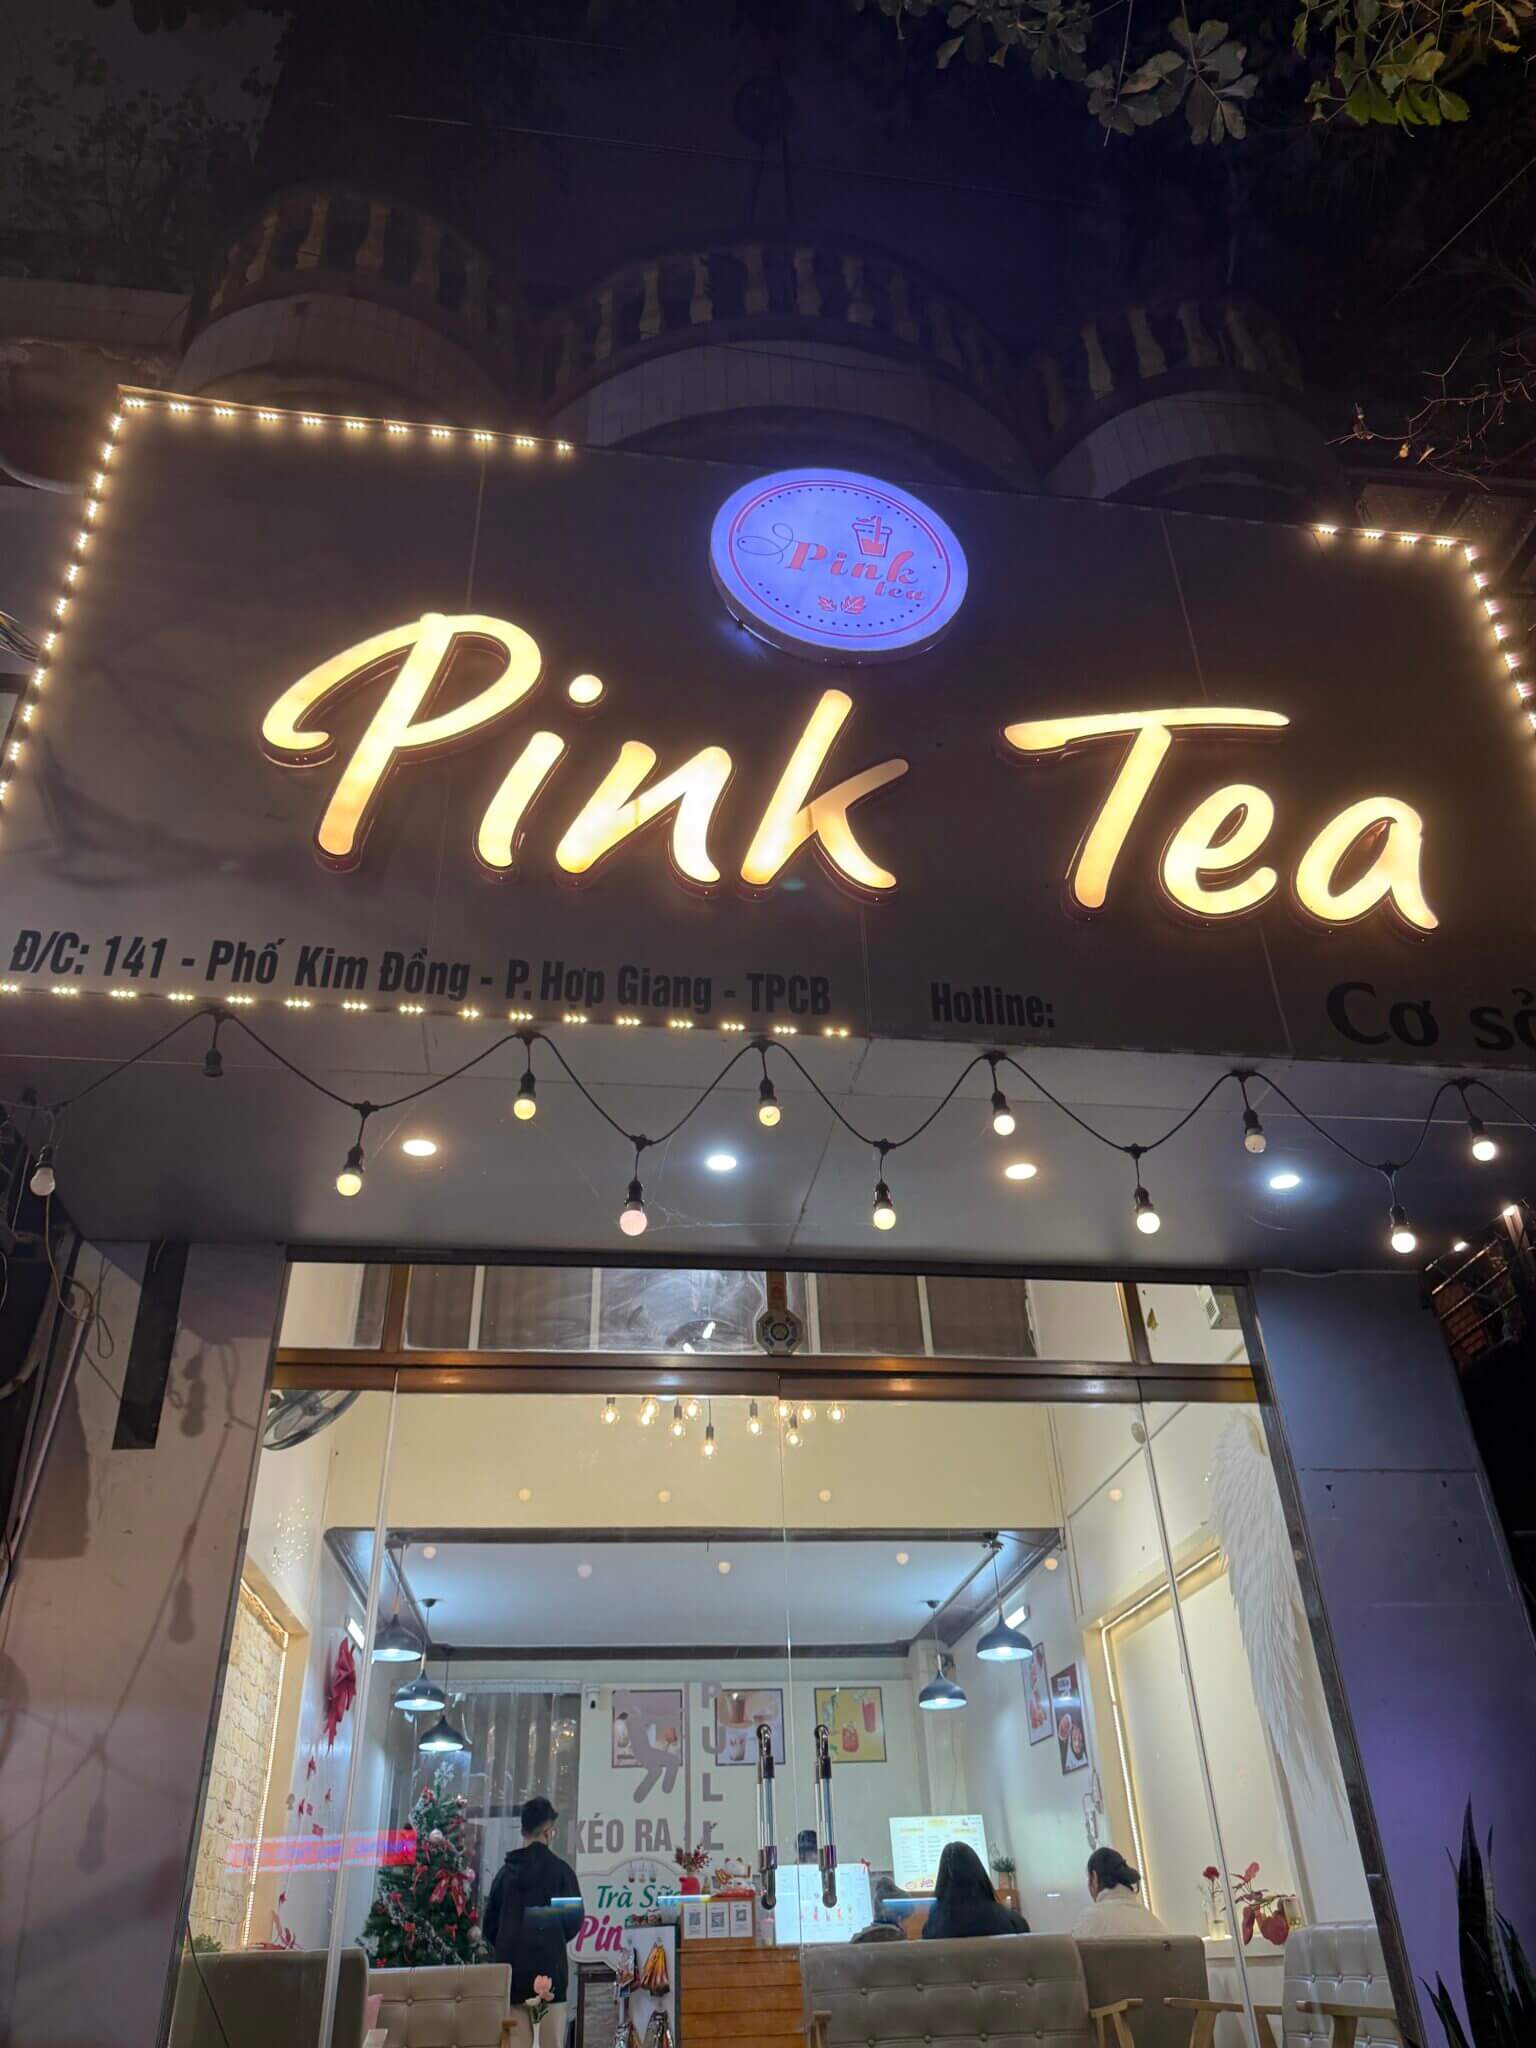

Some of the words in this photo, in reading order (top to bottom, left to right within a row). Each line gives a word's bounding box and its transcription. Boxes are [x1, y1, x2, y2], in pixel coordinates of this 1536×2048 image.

[737, 523, 919, 585] Pink
[262, 613, 908, 889] Pink
[1004, 706, 1439, 930] Tea
[9, 929, 90, 975] Đ/C:
[103, 935, 167, 979] 141
[205, 937, 287, 985] Phố
[294, 945, 369, 991] Kim
[378, 948, 472, 1002] Đồng
[616, 965, 712, 1014] Giang
[746, 973, 831, 1015] TPCB
[930, 981, 1056, 1030] Hotline:
[1326, 981, 1440, 1048] Cơ
[567, 1812, 624, 1854] KÉO
[634, 1818, 672, 1852] RA
[596, 1883, 633, 1909] Trà
[639, 1883, 682, 1909] Sữ
